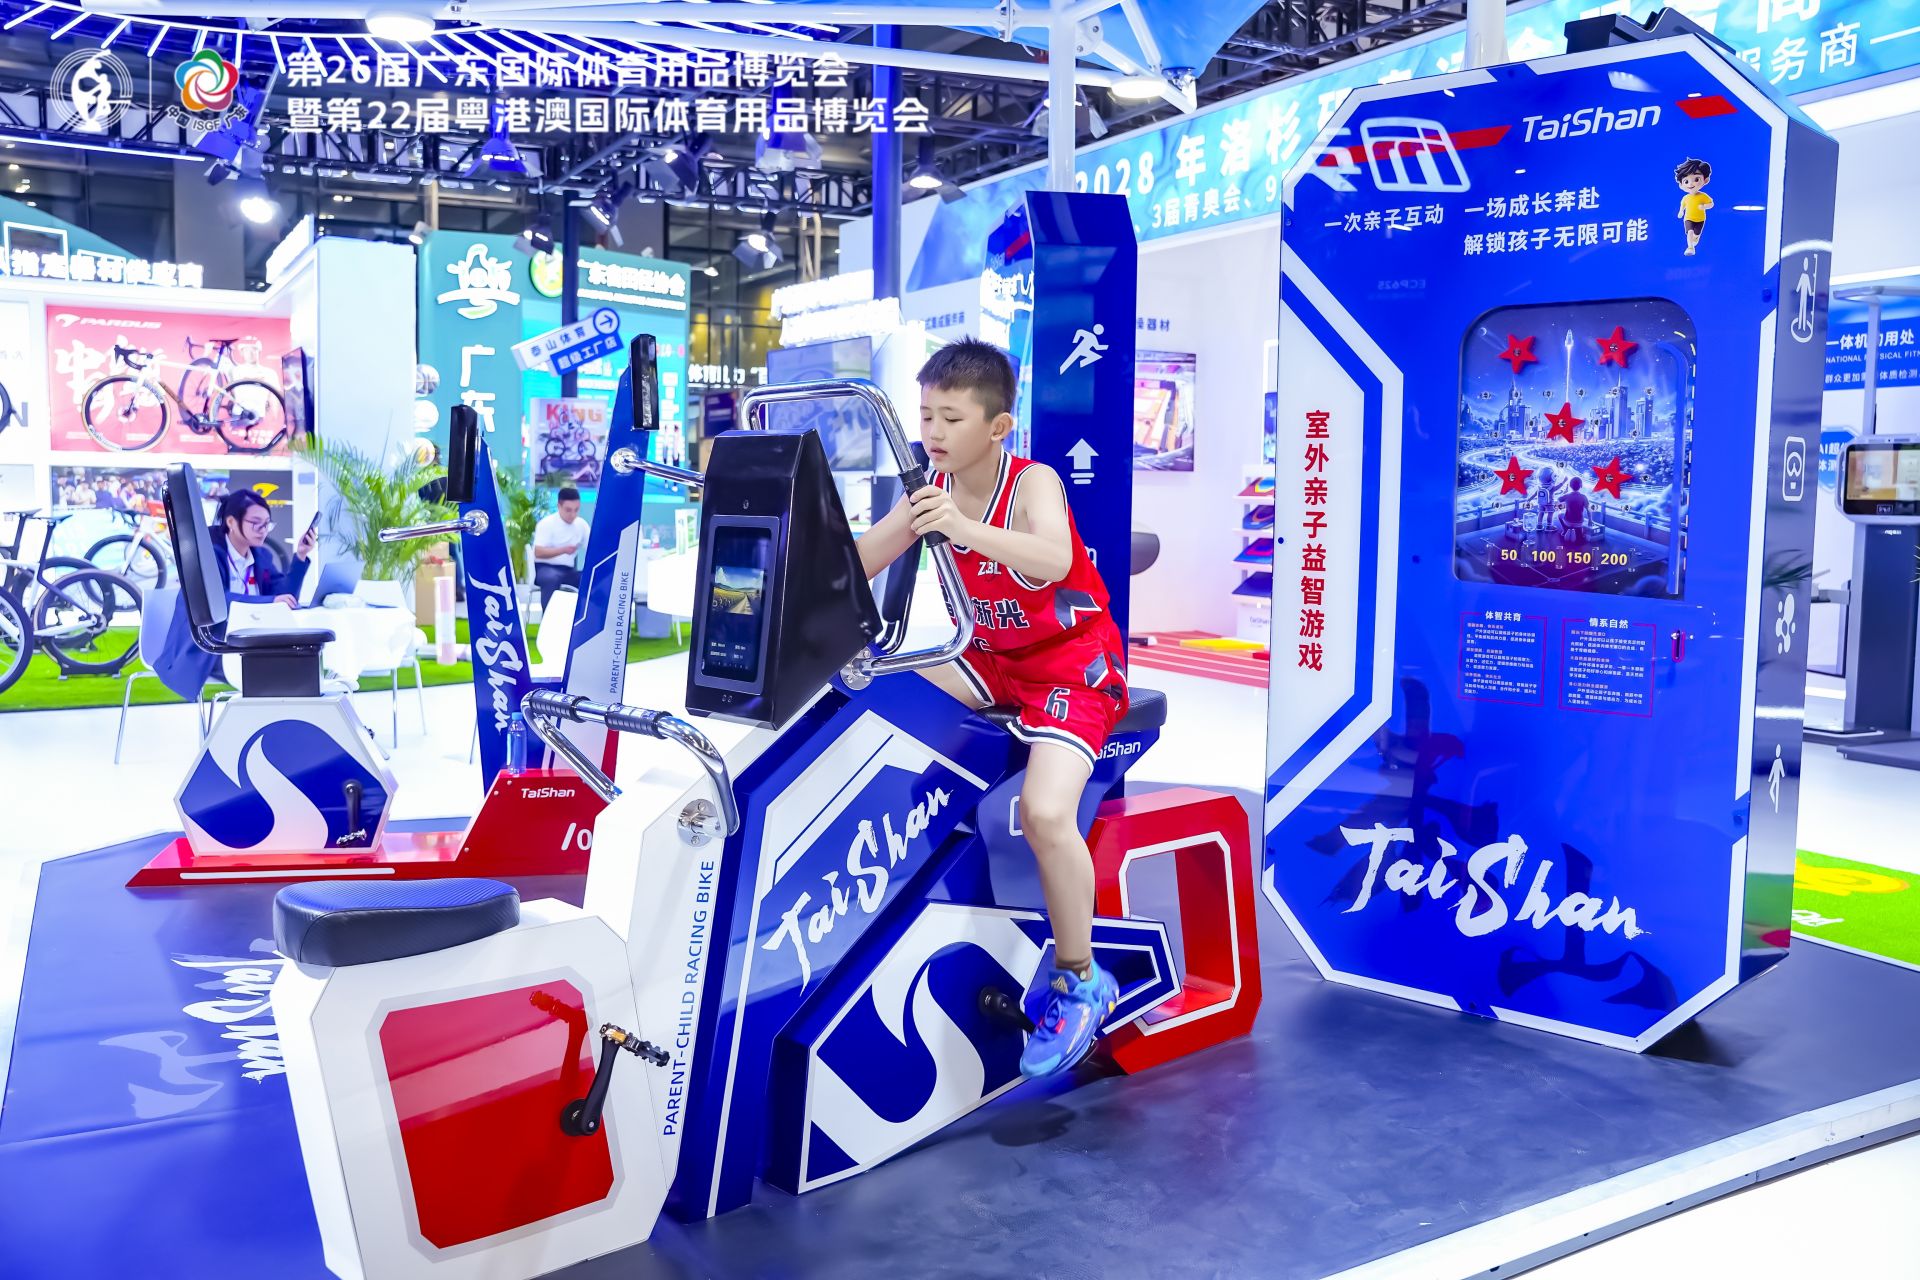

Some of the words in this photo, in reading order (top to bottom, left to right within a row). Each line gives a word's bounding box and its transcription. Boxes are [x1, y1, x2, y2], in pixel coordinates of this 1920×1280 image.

[1522, 105, 1662, 143] TaiShan
[1324, 203, 1445, 233] 一次亲子互动
[1464, 187, 1601, 220] 一场成长奔赴
[1463, 218, 1649, 256] 解锁孩子无限可能
[80, 318, 162, 330] PARDUS
[530, 325, 588, 358] 泰山体育
[557, 335, 618, 371] 超级工厂店
[1825, 354, 1862, 364] NATIONAL
[546, 403, 603, 422] KING
[1298, 409, 1330, 672] 室外亲子益智游戏
[1501, 549, 1518, 561] 50
[1531, 550, 1556, 563] 100
[1566, 551, 1591, 564] 150
[1600, 553, 1628, 566] 200
[620, 571, 630, 591] BIKE
[617, 593, 627, 627] RACING
[1485, 610, 1522, 622] 体智共育
[1588, 617, 1629, 629] 情系自然
[467, 565, 524, 736] TaiShan
[610, 628, 623, 694] PARENT-CHILD
[1044, 686, 1071, 722] 6
[1096, 741, 1141, 761] aiShan
[521, 787, 576, 798] TaiShan
[761, 786, 953, 997] TaiShan
[1338, 822, 1652, 940] TaiShan
[663, 990, 696, 1136] PARENT-CHILD
[684, 909, 707, 984] RACING
[696, 860, 715, 904] BIKE
